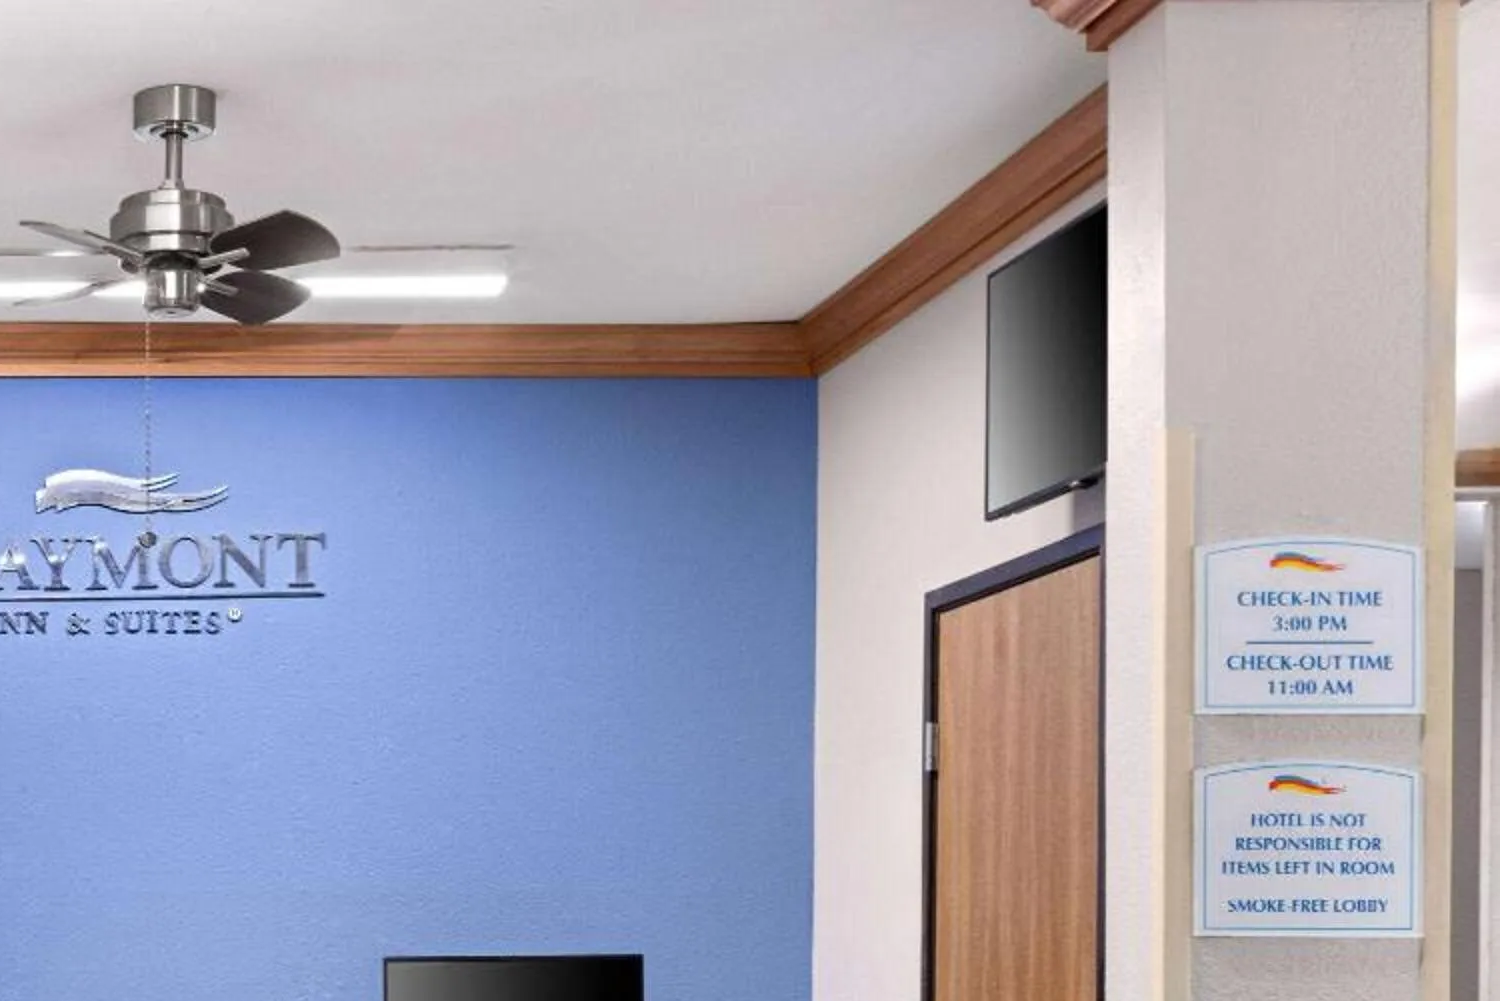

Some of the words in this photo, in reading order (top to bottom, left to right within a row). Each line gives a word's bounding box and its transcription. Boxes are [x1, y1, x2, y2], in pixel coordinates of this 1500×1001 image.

[1237, 591, 1332, 607] CHECK-IN
[1338, 591, 1383, 607] TIME
[67, 612, 91, 636] &
[1272, 615, 1312, 632] 3:00
[1318, 616, 1348, 631] PM
[1226, 655, 1342, 671] CHECK-OUT
[1348, 655, 1393, 671] TIME
[1268, 680, 1317, 695] 11:00
[1320, 680, 1354, 695] AM
[1251, 813, 1302, 827] HOTEL
[1311, 813, 1325, 827] IS
[1330, 813, 1367, 827] NOT
[1235, 837, 1346, 851] RESPONSIBLE
[1349, 837, 1382, 851] FOR
[1221, 861, 1270, 875] ITEMS
[1275, 861, 1310, 875] LEFT
[1316, 861, 1335, 875] IN
[1340, 861, 1395, 875] ROOM
[1227, 899, 1328, 913] SMOKE-FREE
[1333, 899, 1389, 913] LOBBY
